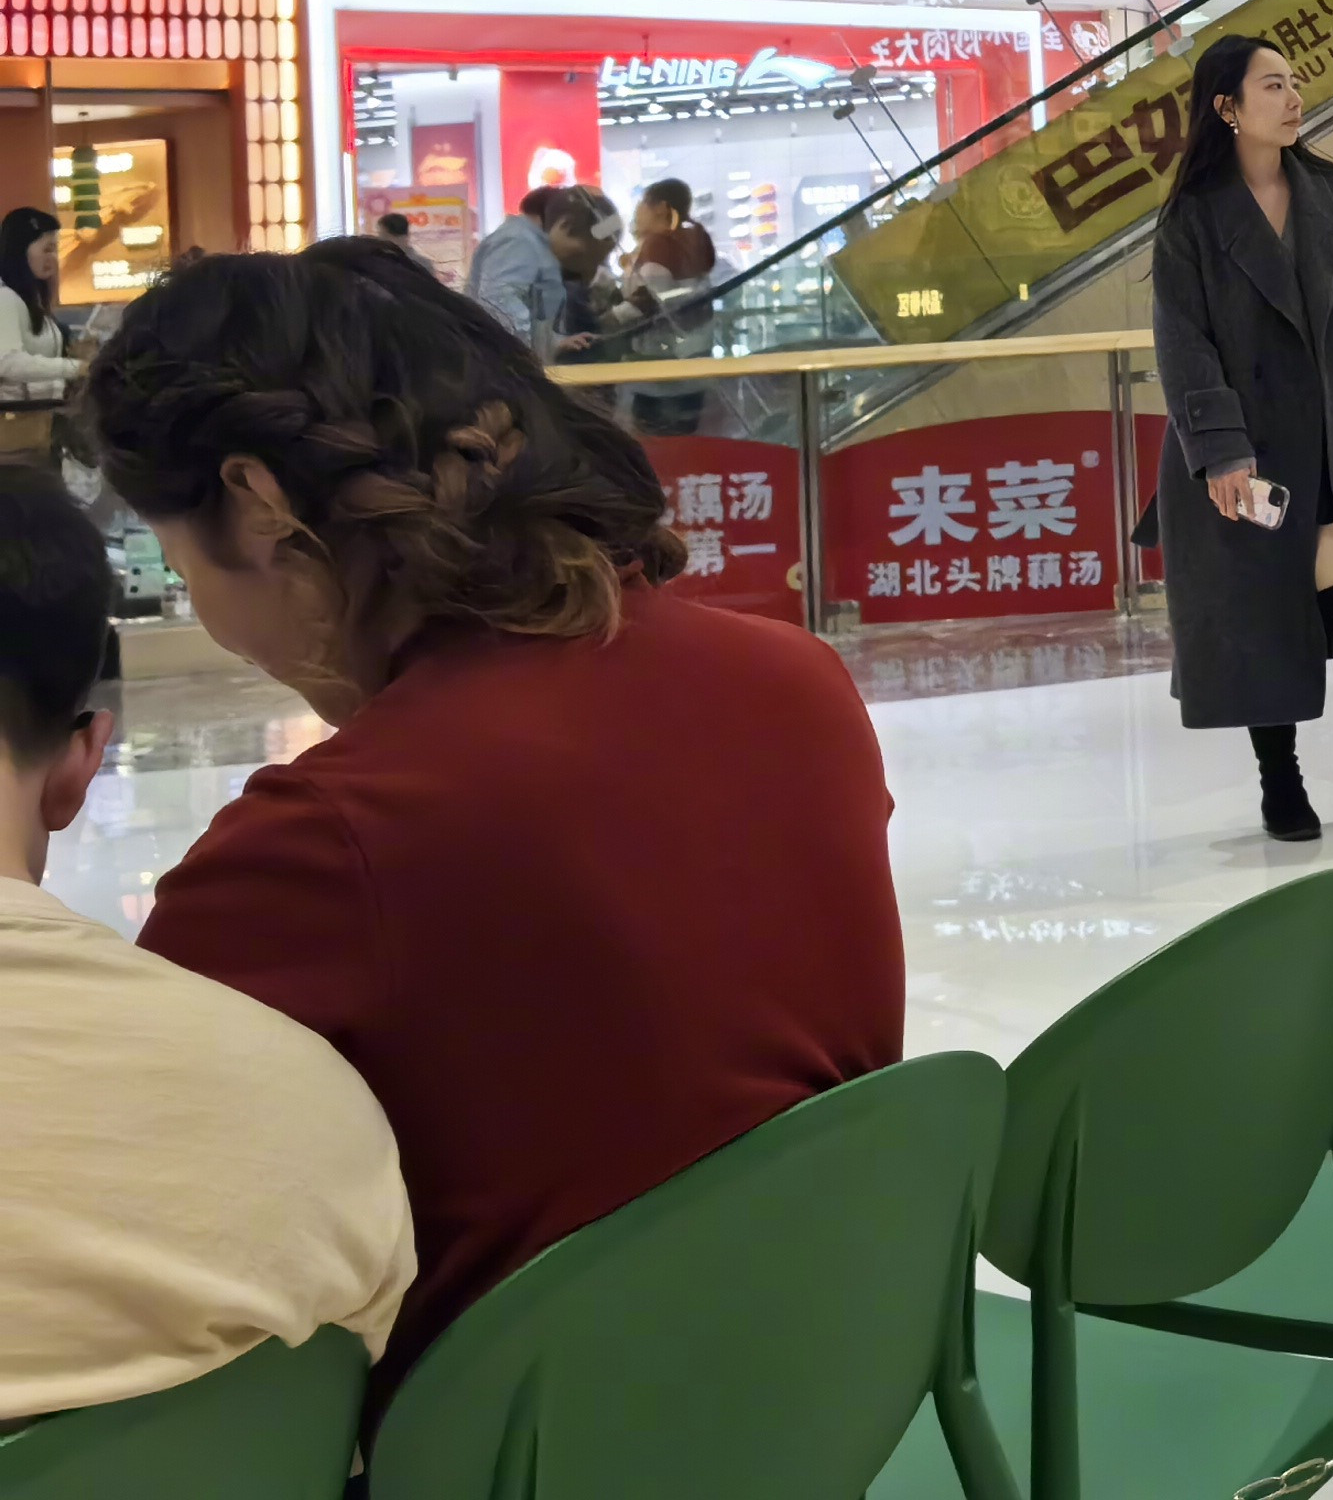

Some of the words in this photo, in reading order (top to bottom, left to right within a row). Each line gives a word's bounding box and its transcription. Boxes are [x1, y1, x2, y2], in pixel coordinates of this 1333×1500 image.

[888, 458, 1077, 546] 来菜
[868, 550, 1102, 597] 湖北头牌藕汤
